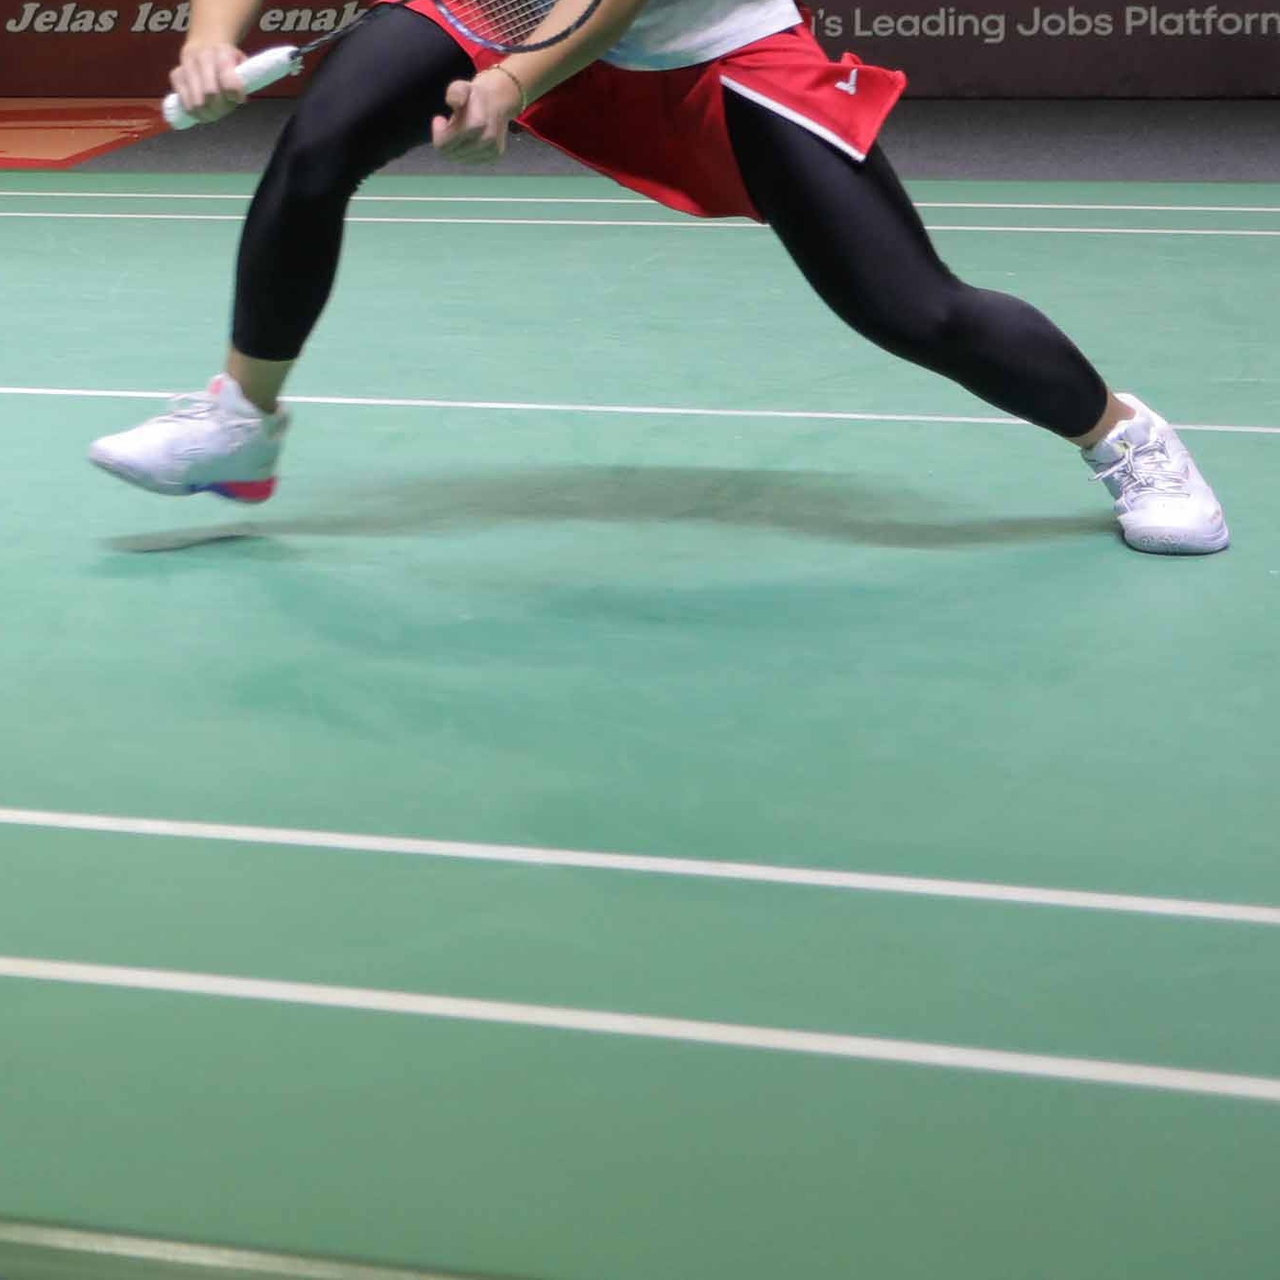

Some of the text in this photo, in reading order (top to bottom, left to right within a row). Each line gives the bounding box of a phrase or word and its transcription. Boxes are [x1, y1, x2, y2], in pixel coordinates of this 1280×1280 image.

[6, 3, 118, 33] Jelas
[130, 2, 190, 33] leb
[854, 6, 1006, 44] Leading
[1017, 6, 1113, 37] Jobs
